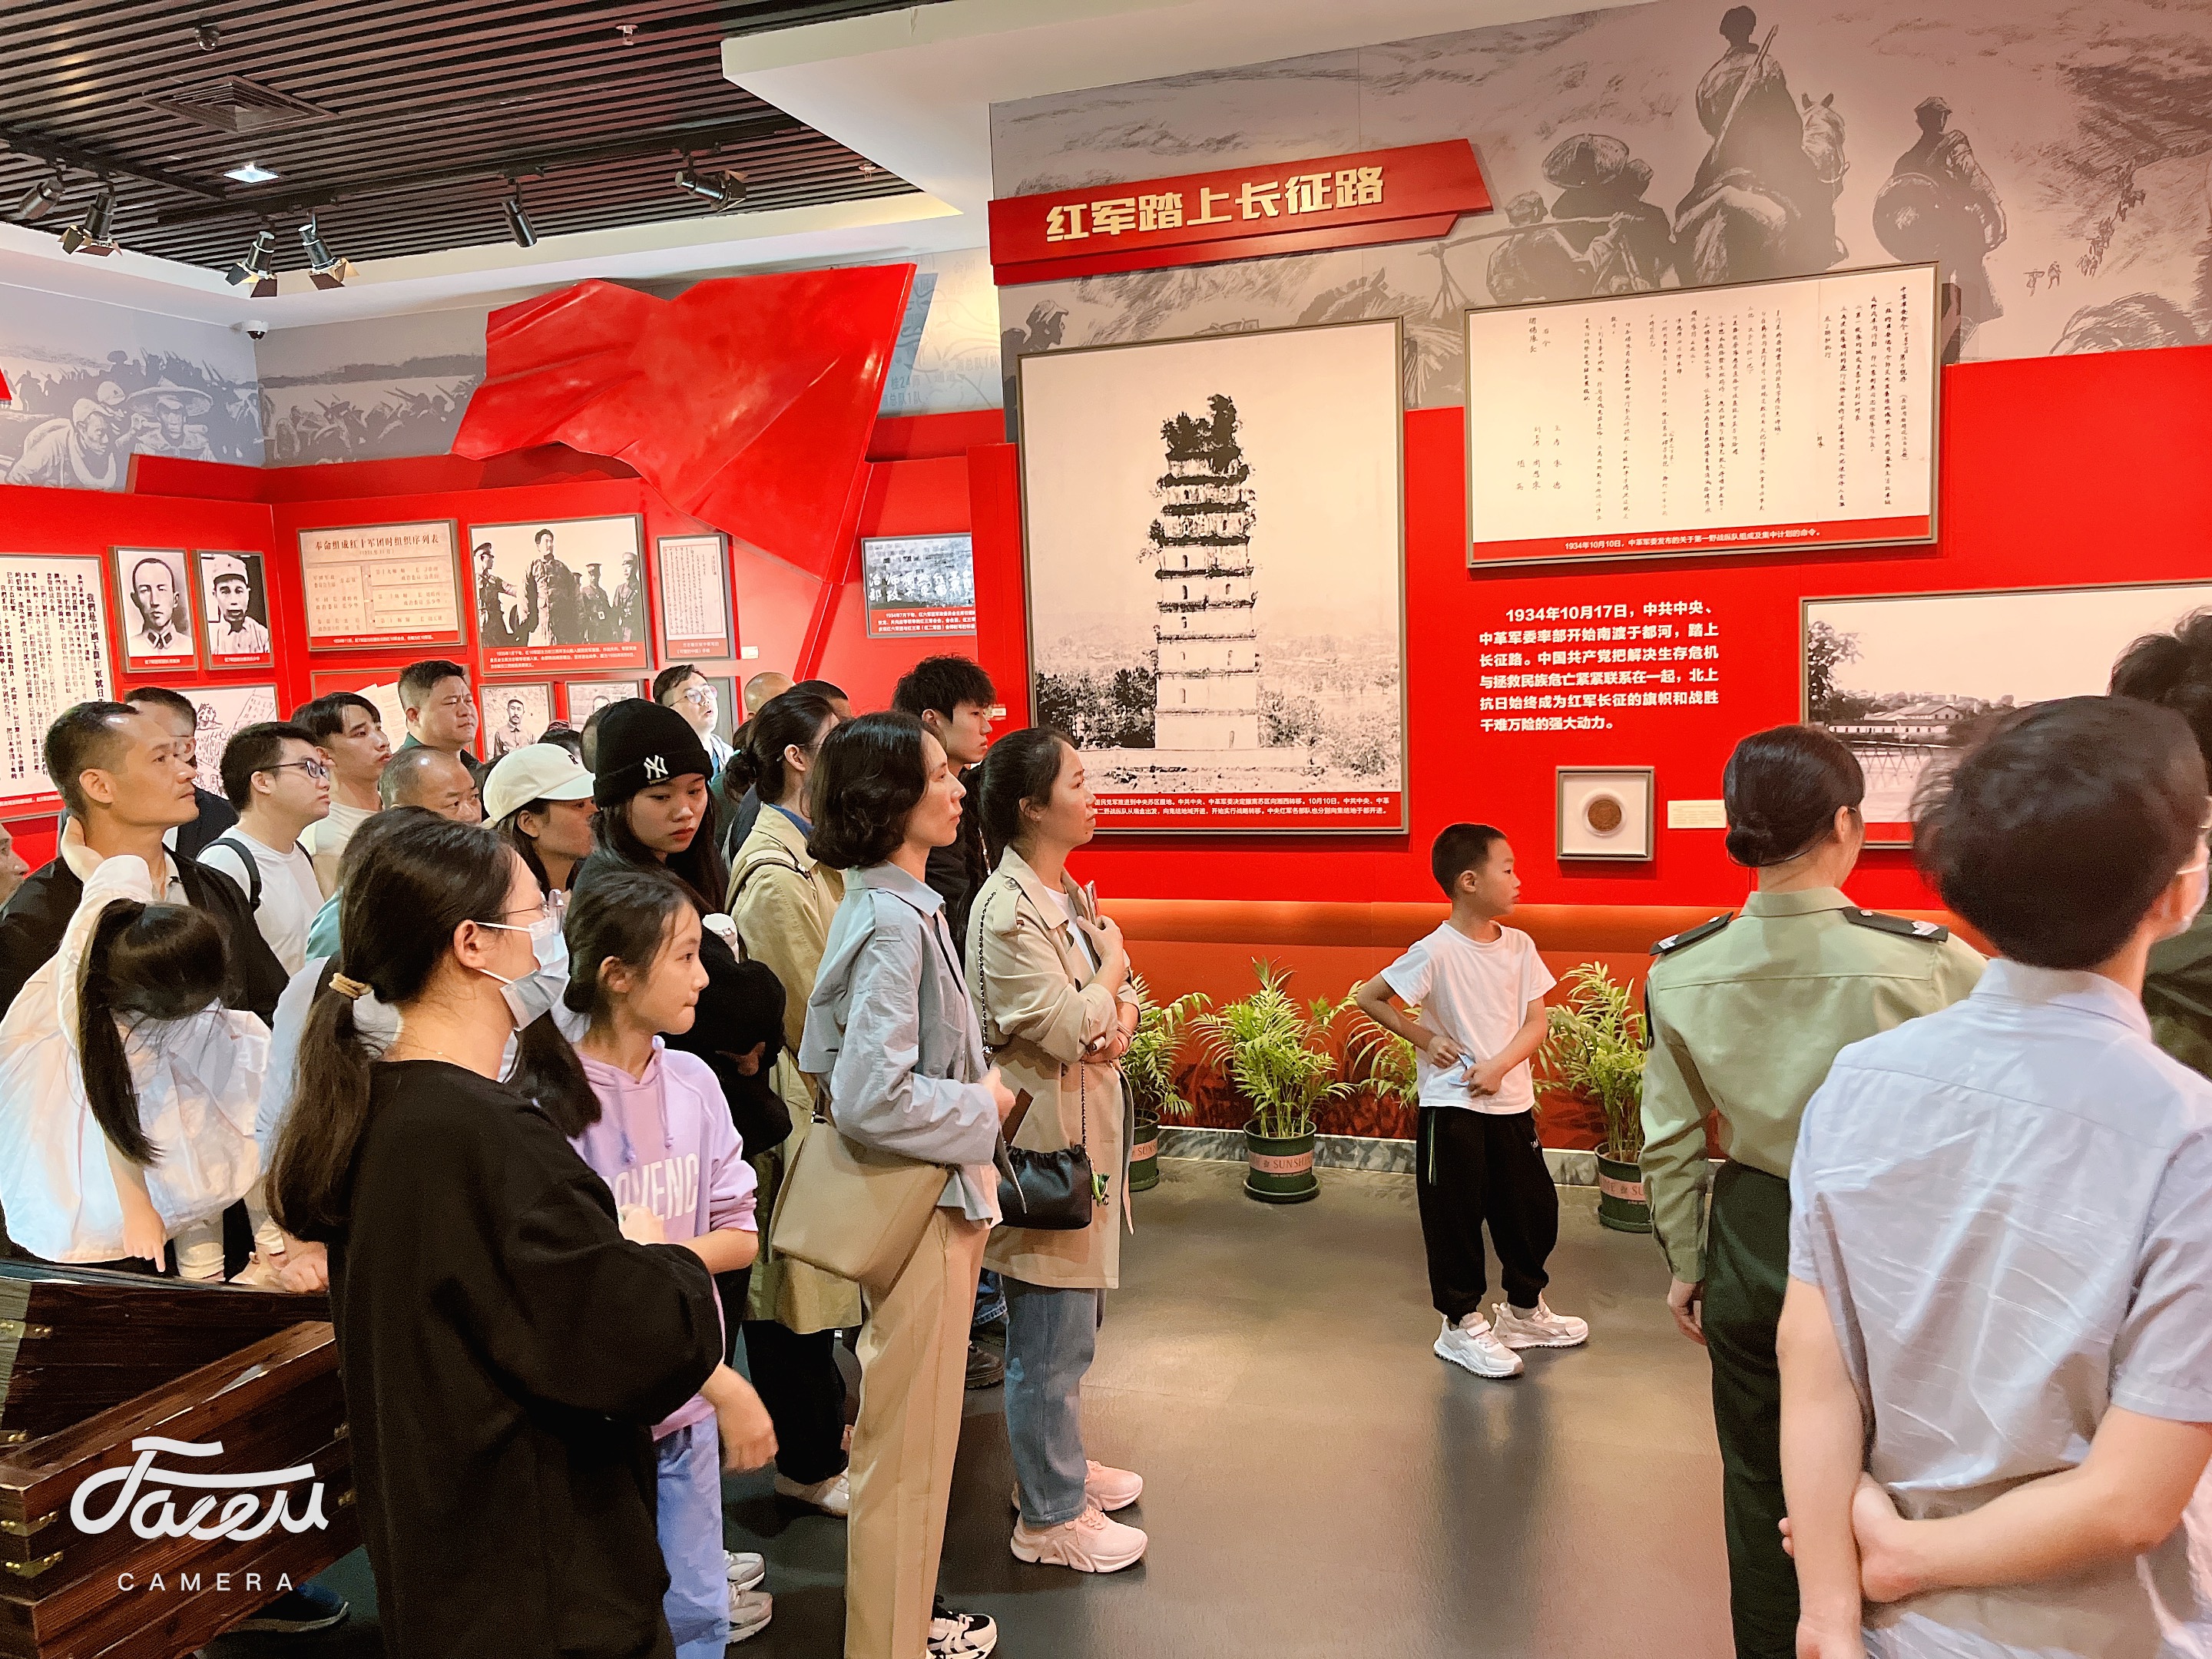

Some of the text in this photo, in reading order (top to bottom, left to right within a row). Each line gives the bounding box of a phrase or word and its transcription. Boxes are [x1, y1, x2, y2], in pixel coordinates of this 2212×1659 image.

[1046, 166, 1385, 243] 红军踏上长征路
[1505, 600, 1713, 622] 1934年10月17日，中共中央、
[1479, 623, 1720, 646] 中革军委率部开始南渡于都河，踏上
[1479, 645, 1720, 667] 长征路。中国共产党把解决生存危机
[1479, 667, 1720, 690] 与拯救民族危亡紧紧联系在一起，北上
[1479, 690, 1720, 711] 抗日始终成为红军长征的旗帜和战胜
[1479, 716, 1614, 733] 千难万险的强大动力。
[568, 754, 578, 765] R
